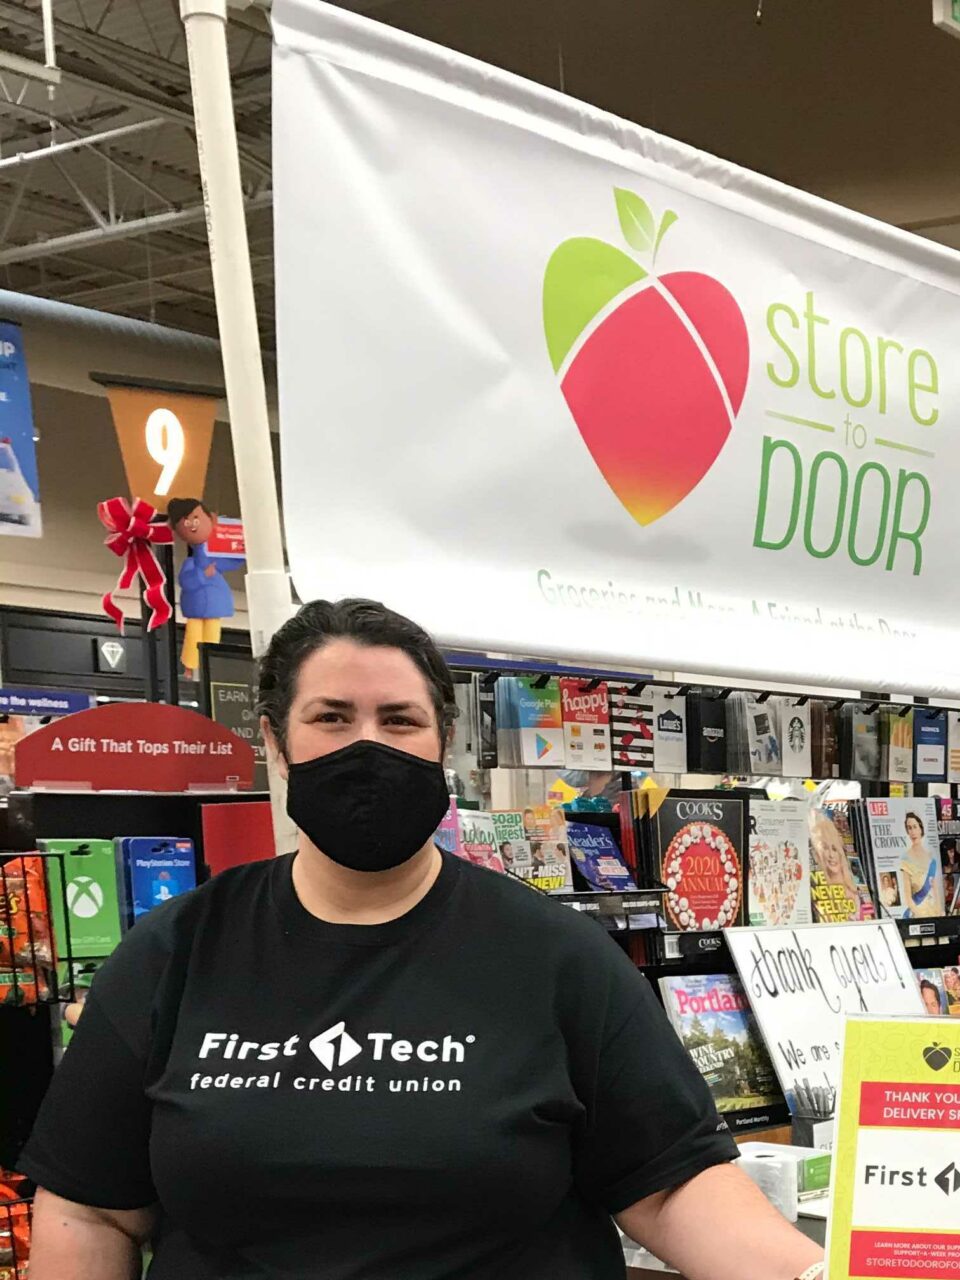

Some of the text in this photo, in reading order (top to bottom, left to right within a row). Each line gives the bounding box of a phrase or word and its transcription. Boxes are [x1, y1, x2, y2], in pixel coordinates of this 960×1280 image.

[766, 291, 940, 426] store
[843, 412, 868, 450] to
[145, 408, 185, 496] 9
[752, 435, 932, 577] DOOR
[218, 689, 249, 702] EARN
[562, 688, 609, 714] happy
[51, 737, 233, 756] A Gift That Tops Their List
[676, 801, 724, 820] COOK'S
[871, 801, 888, 815] LIFE
[491, 813, 523, 825] soap
[872, 824, 893, 836] THE
[874, 836, 908, 849] CROWN
[136, 859, 173, 869] PlayStation
[685, 856, 720, 876] 2020
[681, 877, 727, 892] ANNUAL
[812, 885, 846, 900] NEVER
[750, 931, 841, 1013] thank
[675, 987, 751, 1016] Portlan
[198, 1032, 301, 1061] First
[778, 1039, 831, 1071] We are
[190, 1071, 462, 1093] federal credit union
[884, 1090, 931, 1104] THANK
[882, 1106, 946, 1121] DELIVERY
[864, 1164, 928, 1187] First
[874, 1241, 893, 1249] LEARN
[893, 1242, 911, 1250] MORE
[932, 1243, 946, 1251] OUR
